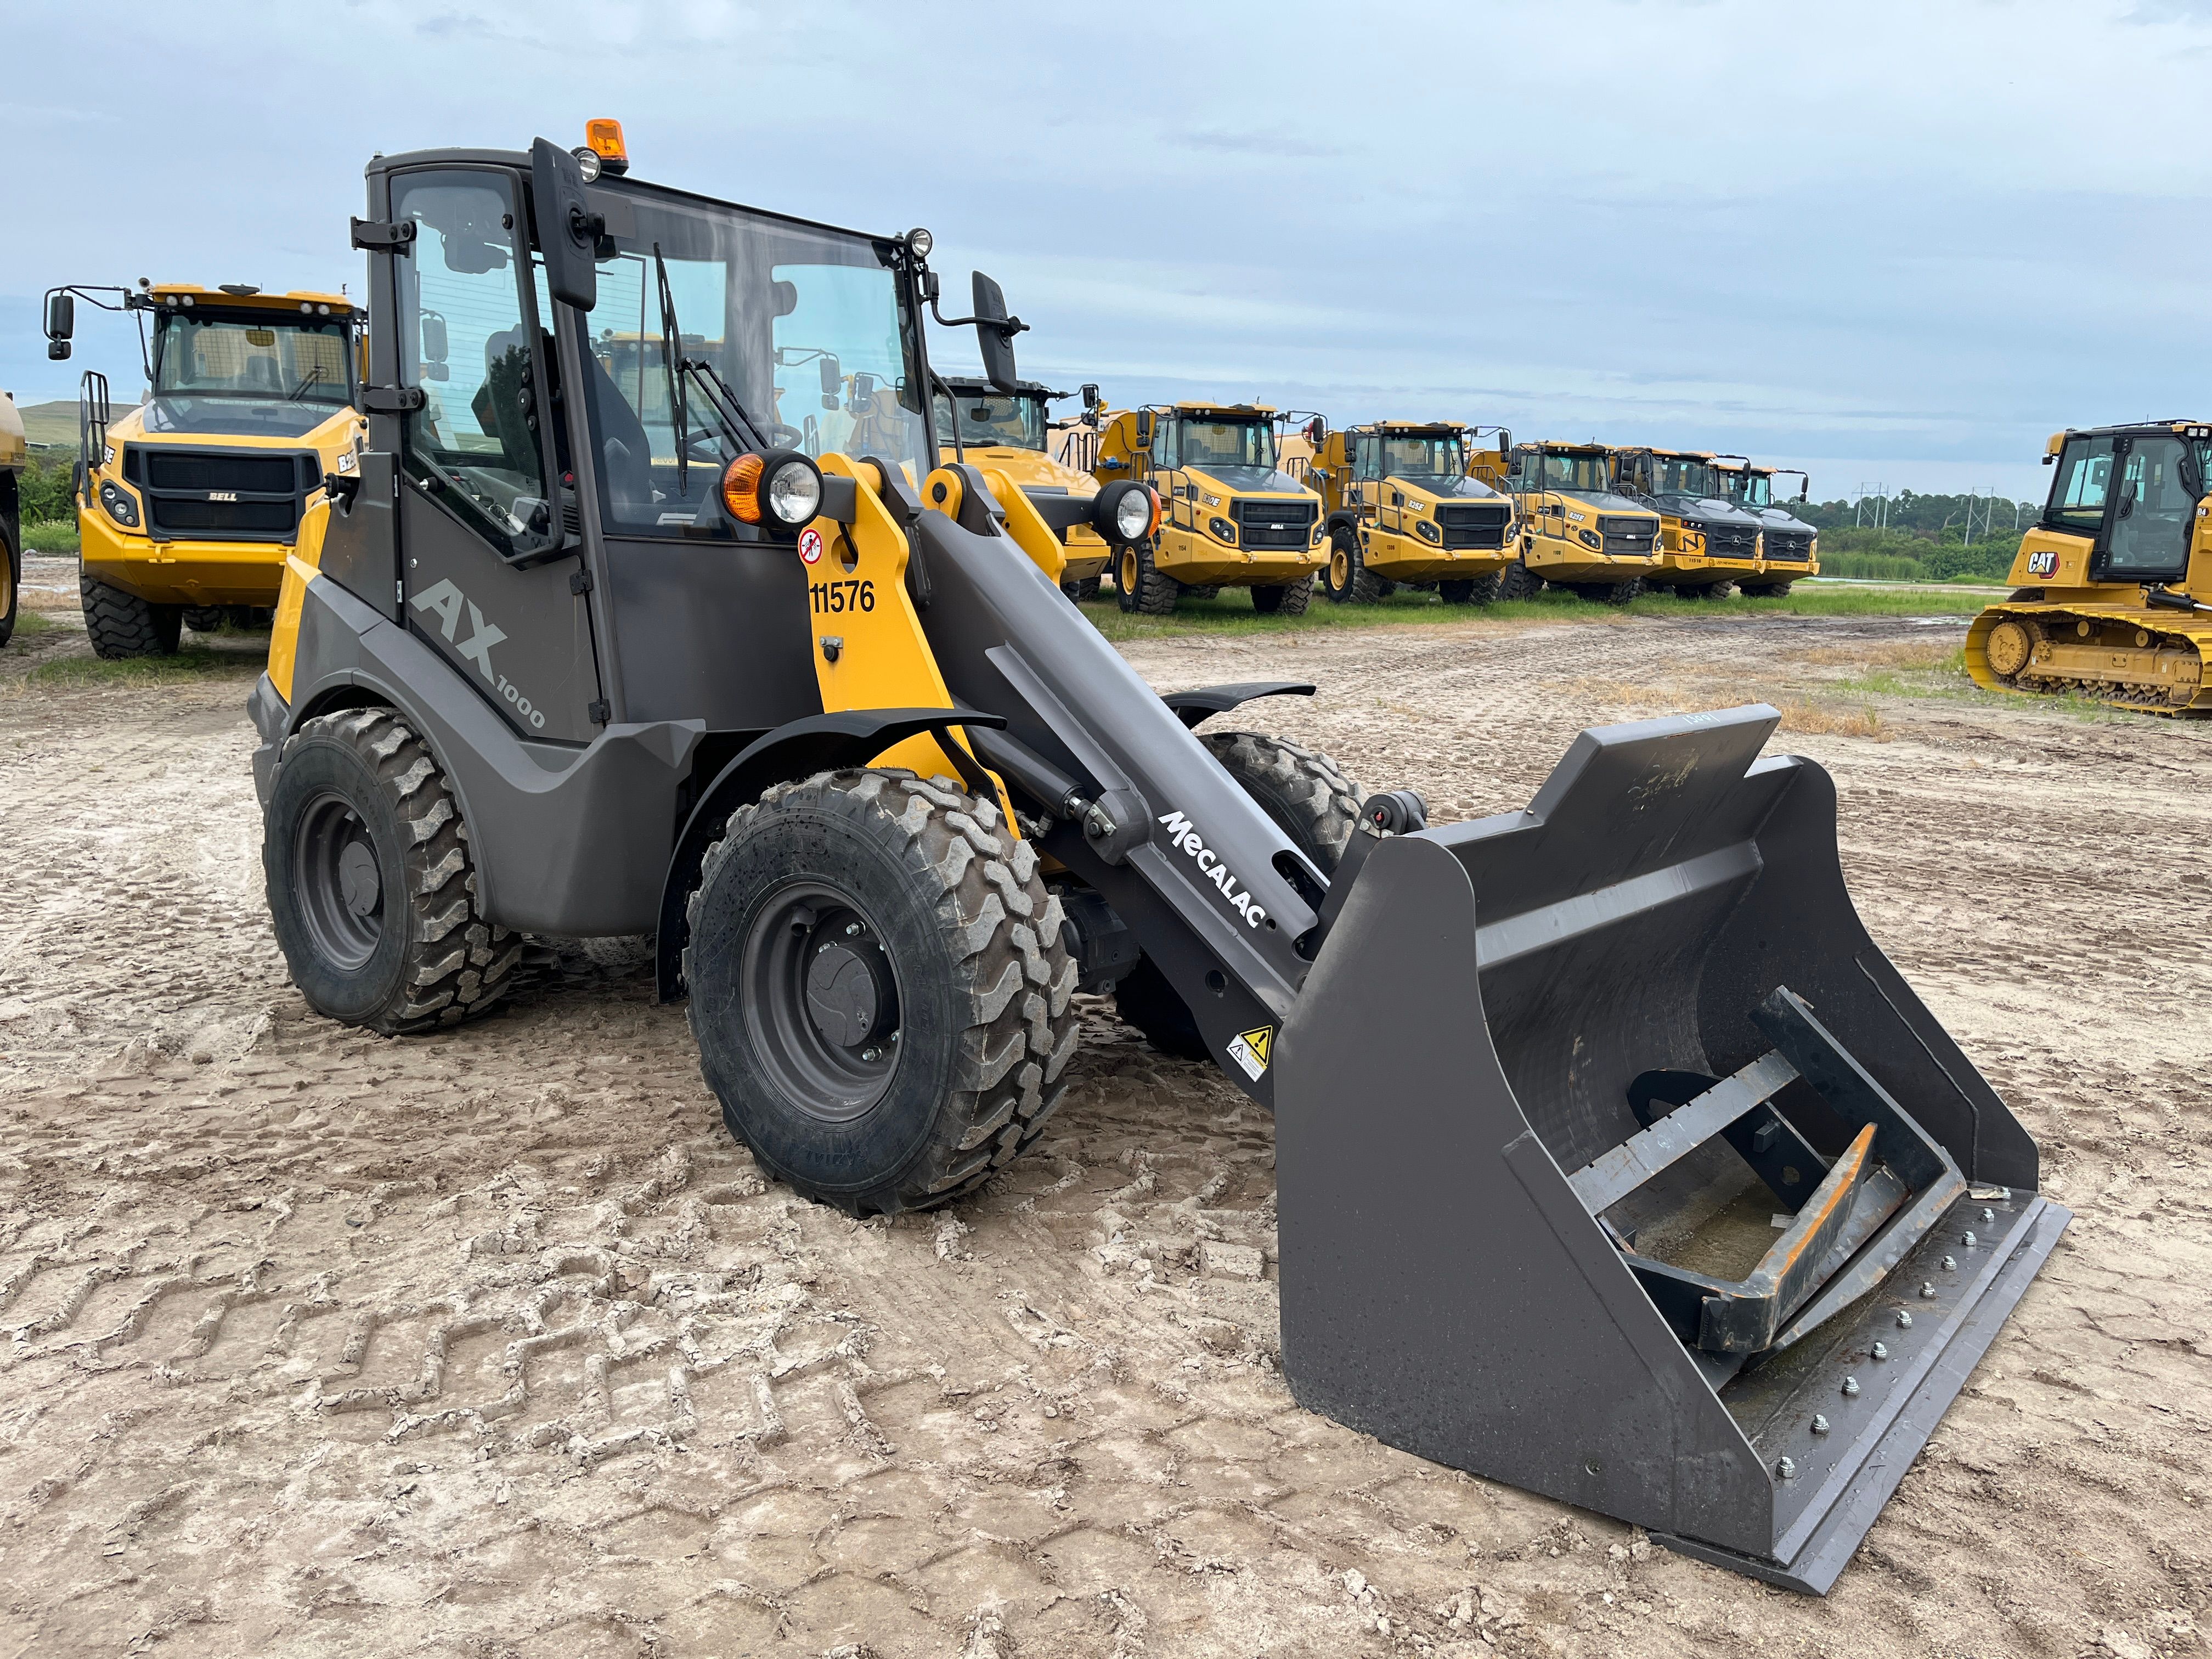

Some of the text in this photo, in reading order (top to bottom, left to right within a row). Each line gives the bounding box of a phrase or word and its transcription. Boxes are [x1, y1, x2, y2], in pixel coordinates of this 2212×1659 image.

[209, 492, 237, 501] BELL
[1202, 493, 1221, 507] B30E
[1408, 499, 1425, 512] B25E
[2197, 507, 2206, 516] D4
[1568, 511, 1585, 522] B25E
[2028, 552, 2055, 573] CAT
[809, 579, 875, 613] 11576
[408, 578, 545, 729] AX 1000
